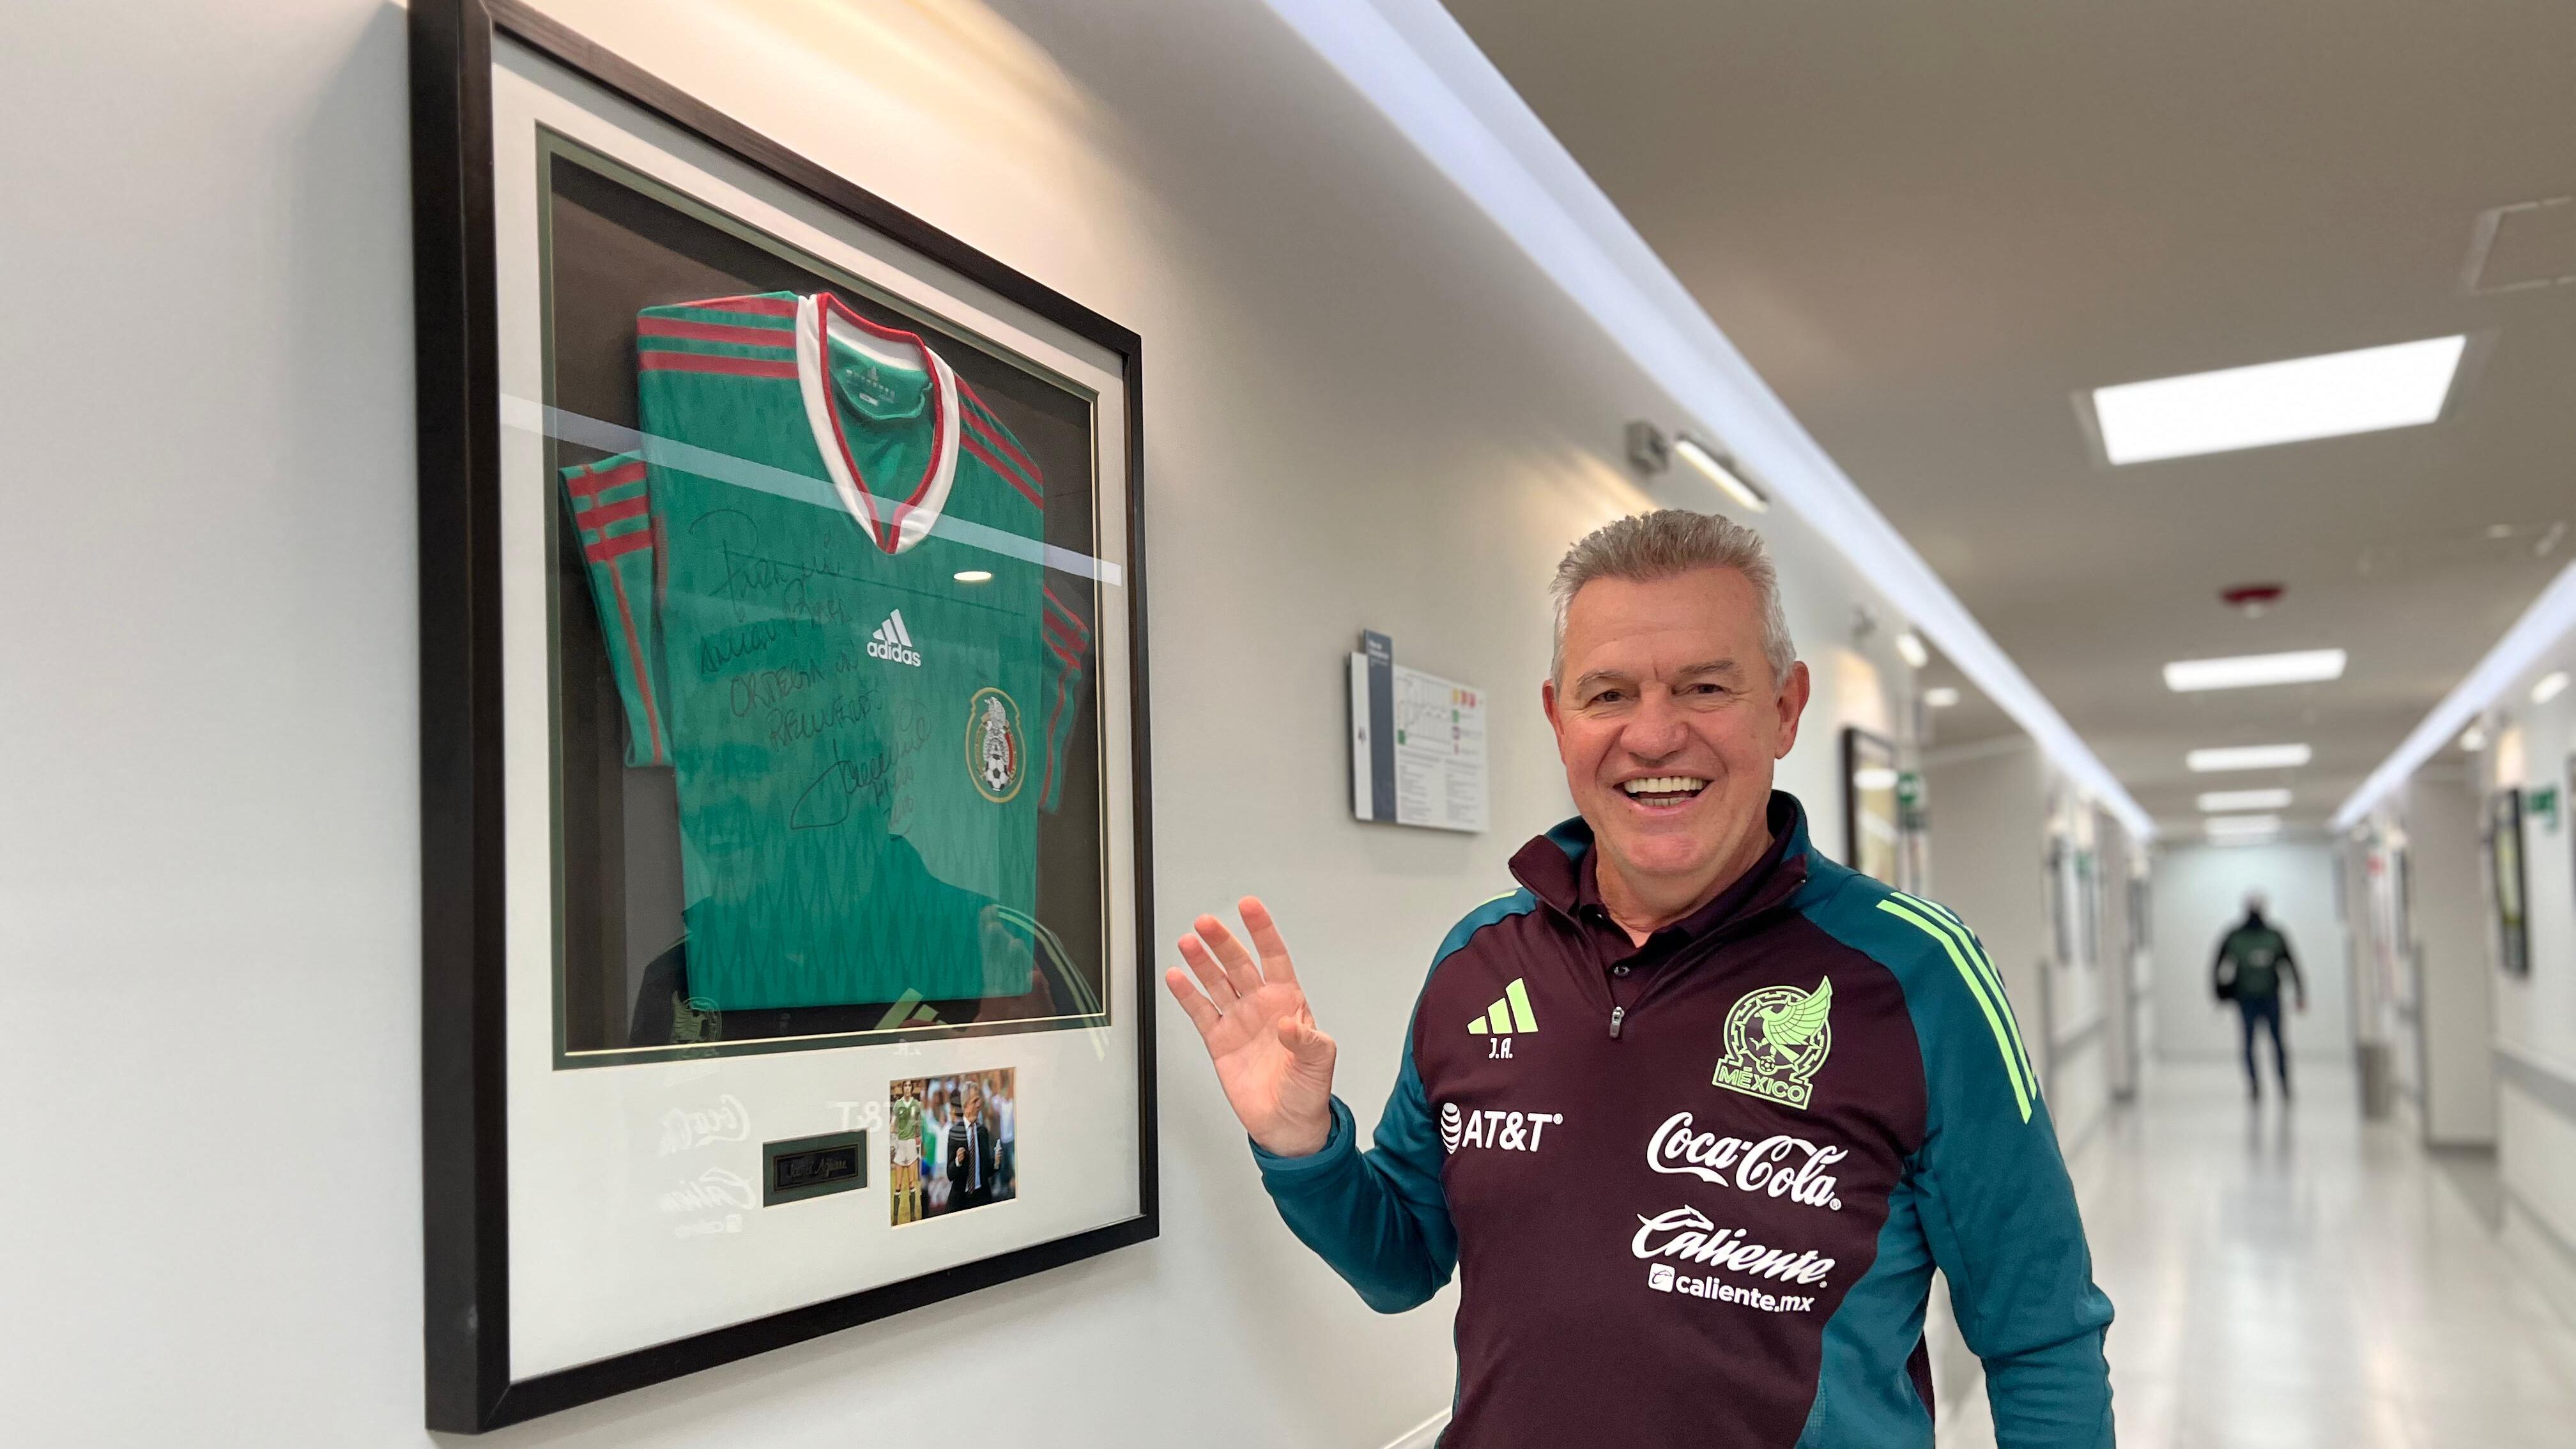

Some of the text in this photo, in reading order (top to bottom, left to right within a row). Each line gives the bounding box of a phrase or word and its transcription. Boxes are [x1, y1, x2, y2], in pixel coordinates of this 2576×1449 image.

[866, 640, 921, 668] adidas
[1489, 1038, 1513, 1059] J.A.
[1462, 1110, 1554, 1152] AT&T
[1647, 1112, 1848, 1208] Coca-Cola
[1632, 1204, 1836, 1285] Caliente
[1676, 1275, 1815, 1312] caliente.mx
